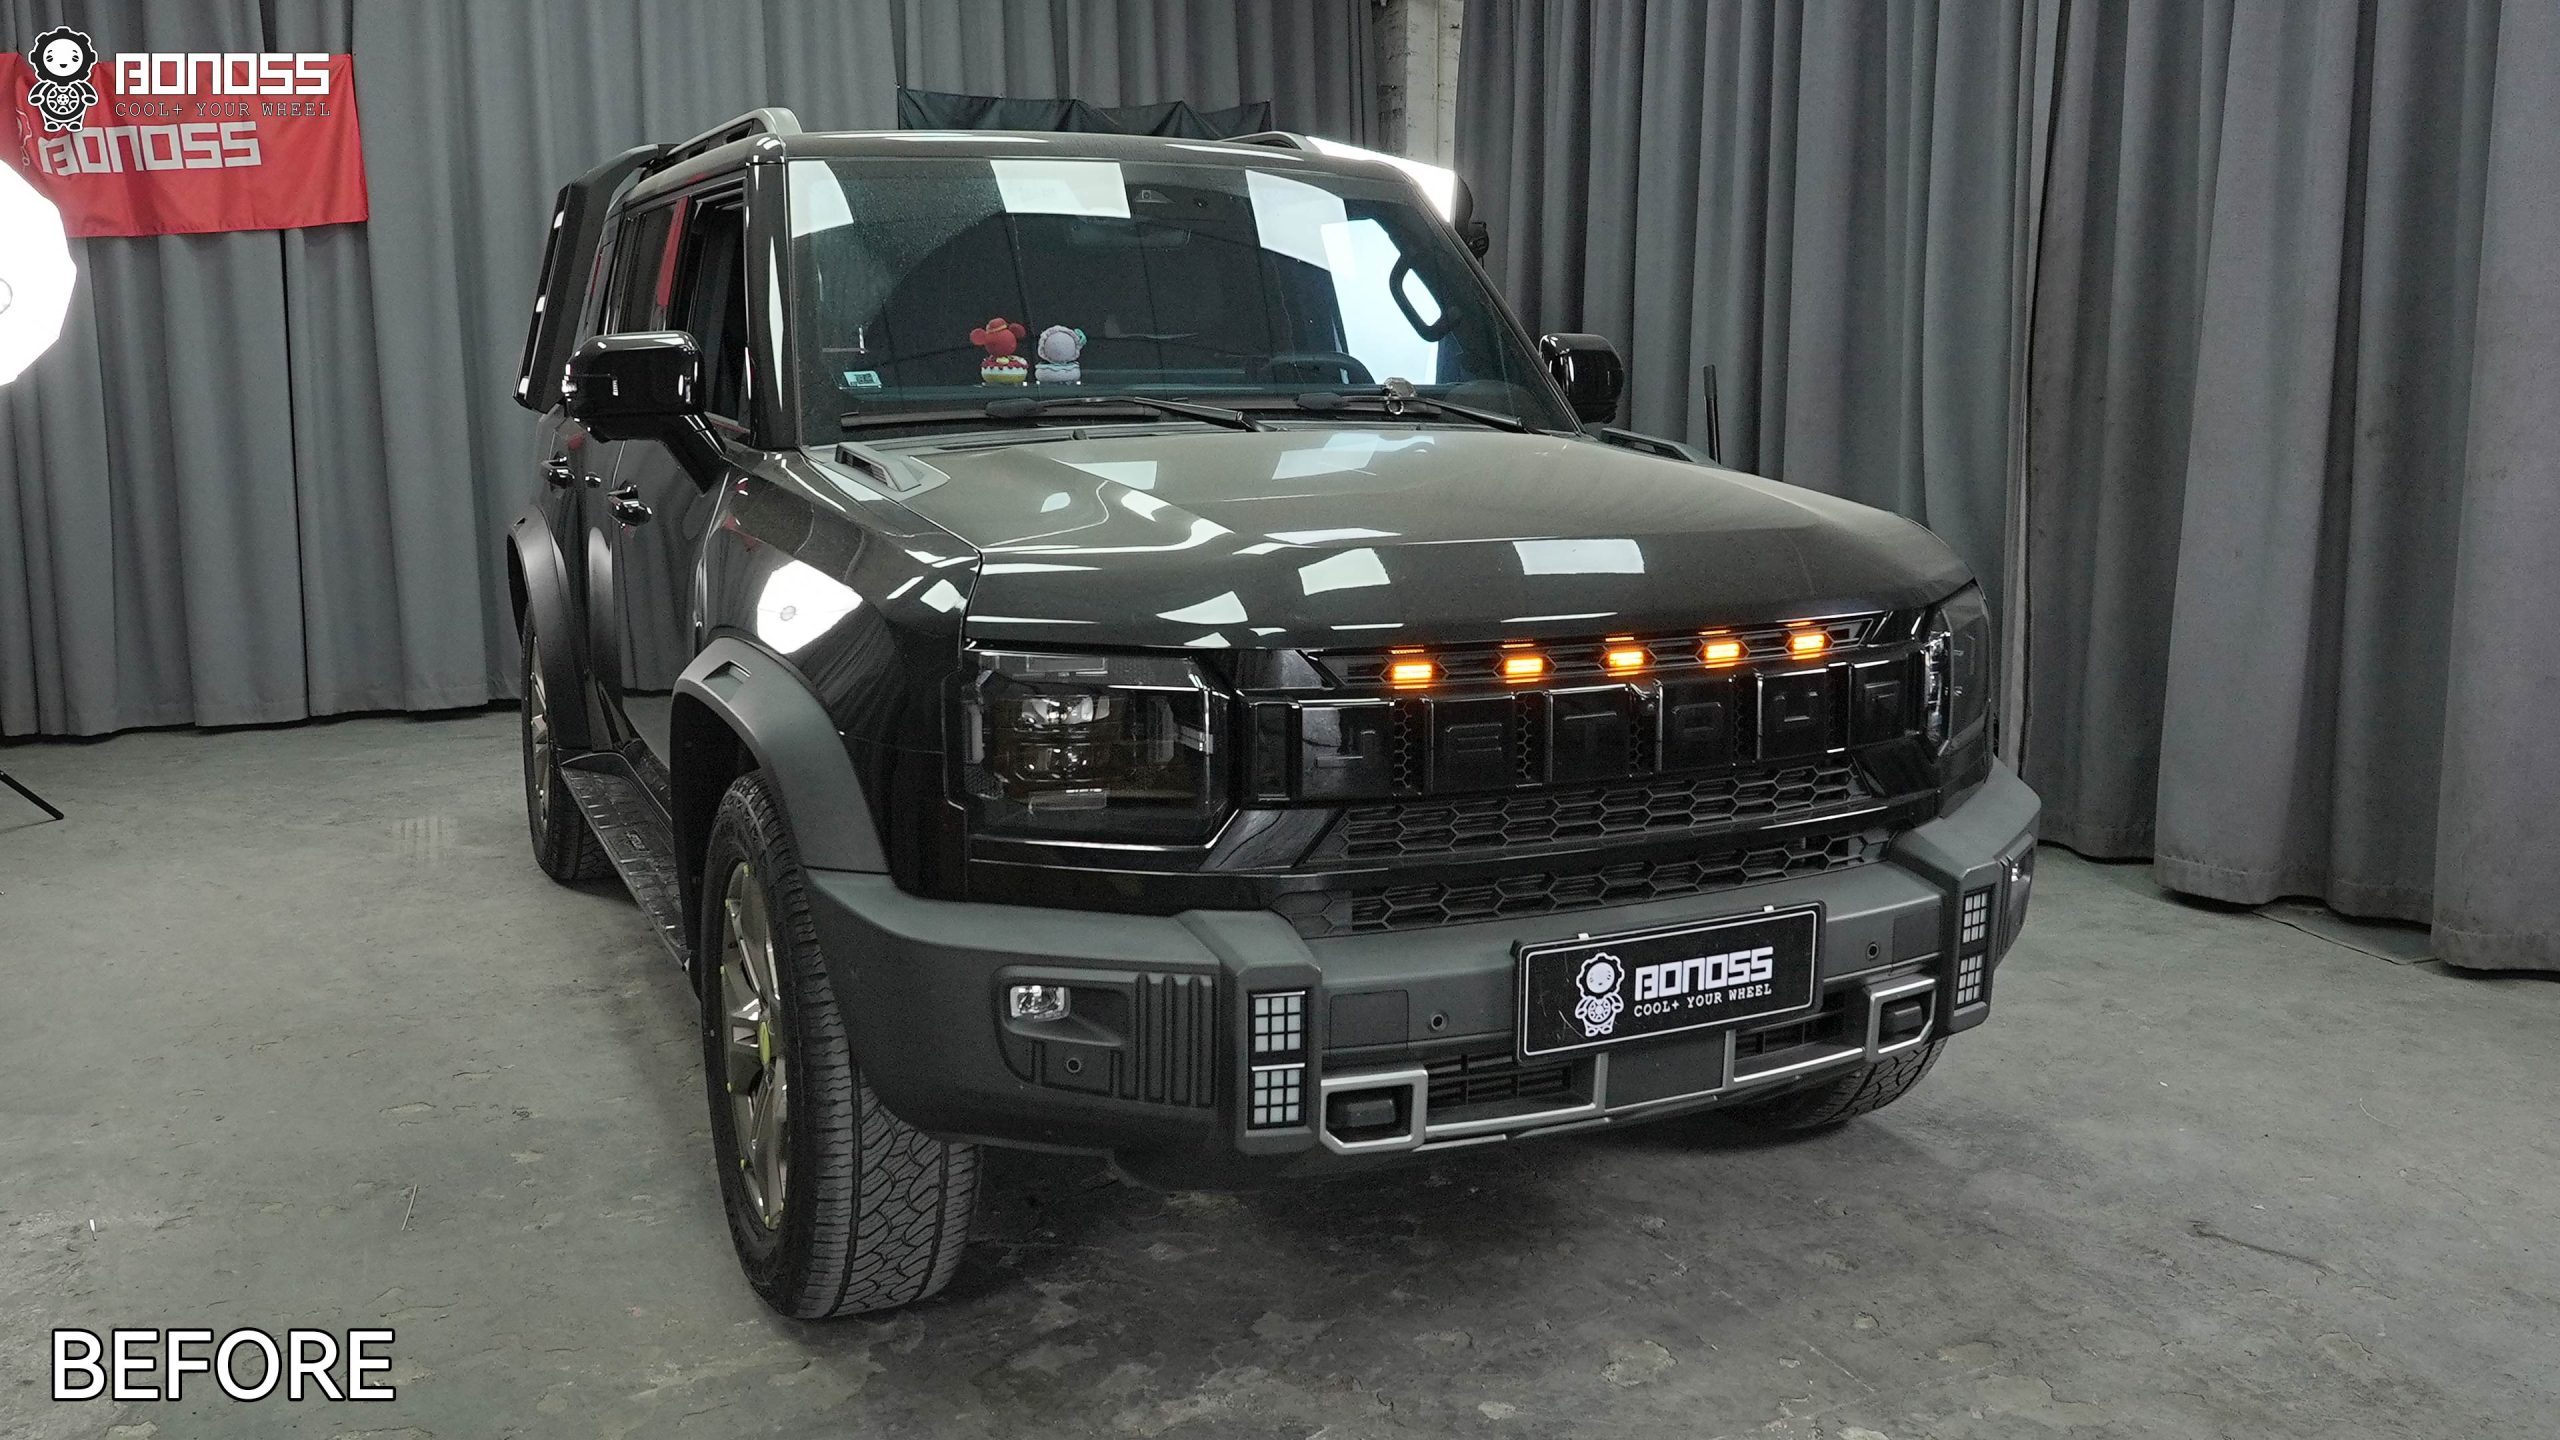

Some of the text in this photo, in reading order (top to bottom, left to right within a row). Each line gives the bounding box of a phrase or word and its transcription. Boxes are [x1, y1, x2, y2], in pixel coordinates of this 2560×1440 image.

[38, 121, 262, 176] BONOSS
[1634, 985, 1772, 1017] COOL+ YOUR WHEEL
[1635, 947, 1773, 1001] BONOSS
